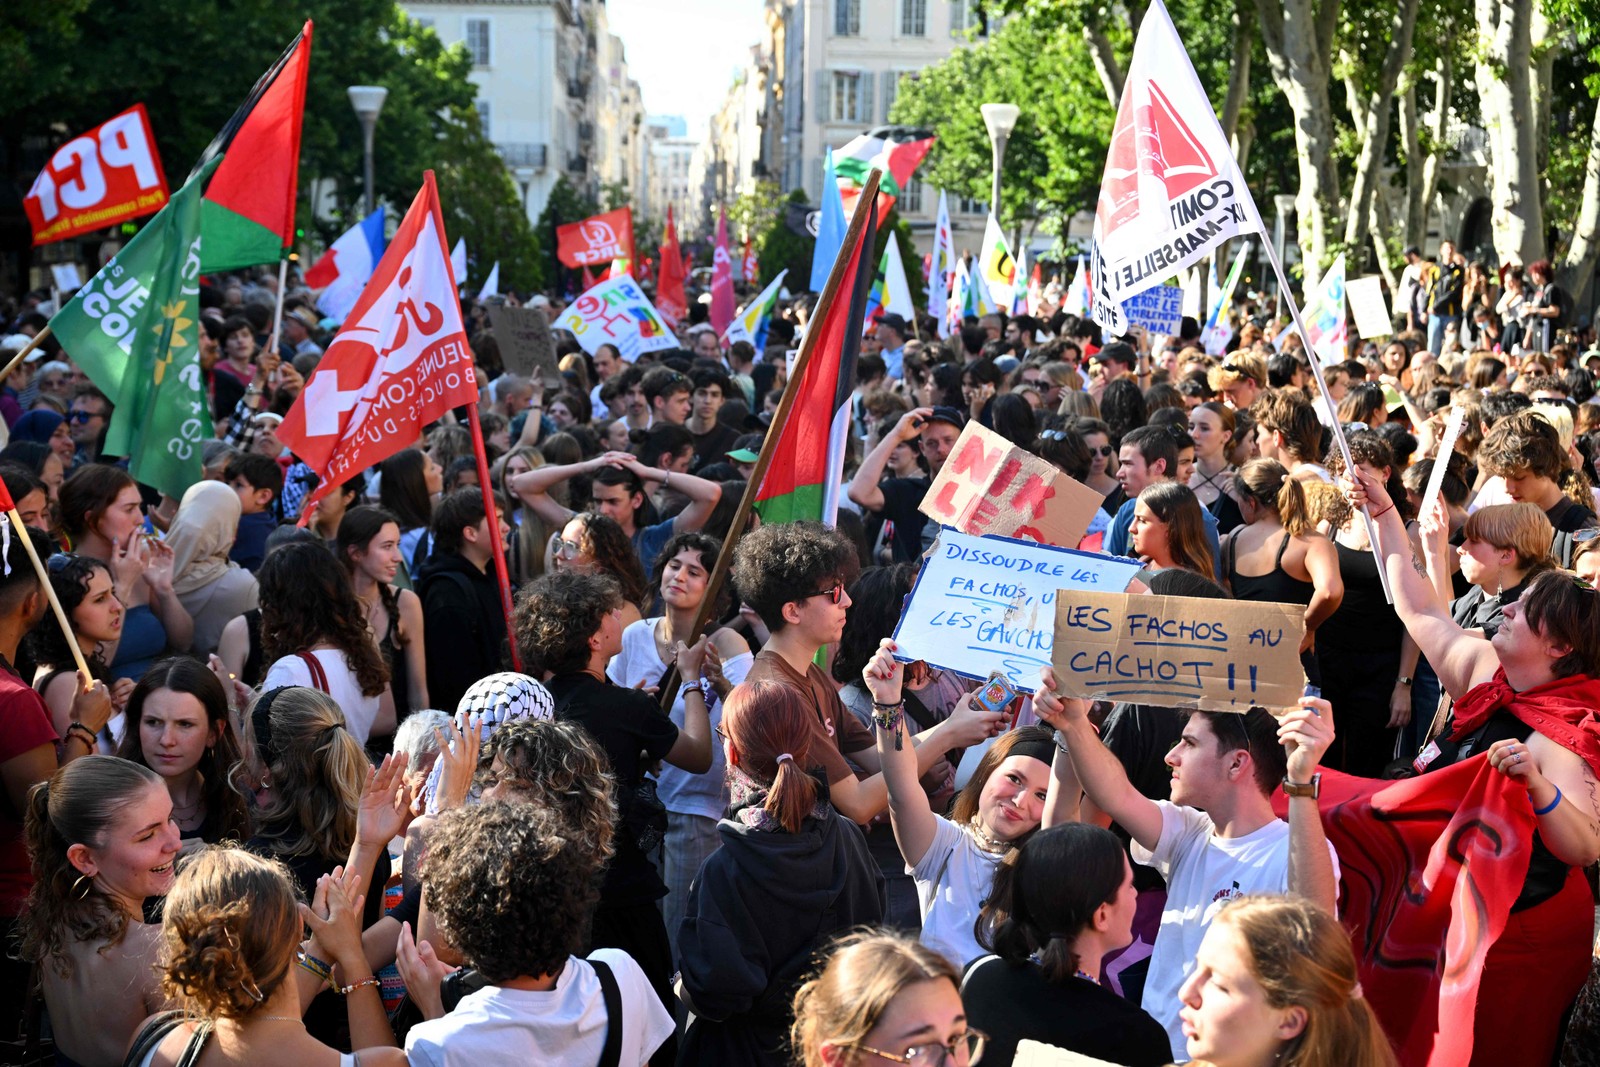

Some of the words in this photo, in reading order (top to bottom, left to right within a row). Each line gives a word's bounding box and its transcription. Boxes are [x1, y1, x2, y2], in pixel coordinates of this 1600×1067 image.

[1126, 306, 1183, 321] EMBLEMENT
[1162, 299, 1181, 312] LE
[951, 434, 1056, 520] NIK
[945, 543, 1065, 577] DISSOUDRE
[1070, 566, 1100, 585] LES
[1042, 592, 1054, 605] U
[930, 610, 977, 629] LES
[976, 620, 1056, 654] GAUCHO
[1066, 605, 1112, 632] LES
[1127, 614, 1229, 642] FACHOS
[1249, 628, 1283, 647] AU
[1070, 650, 1214, 690] CACHOT
